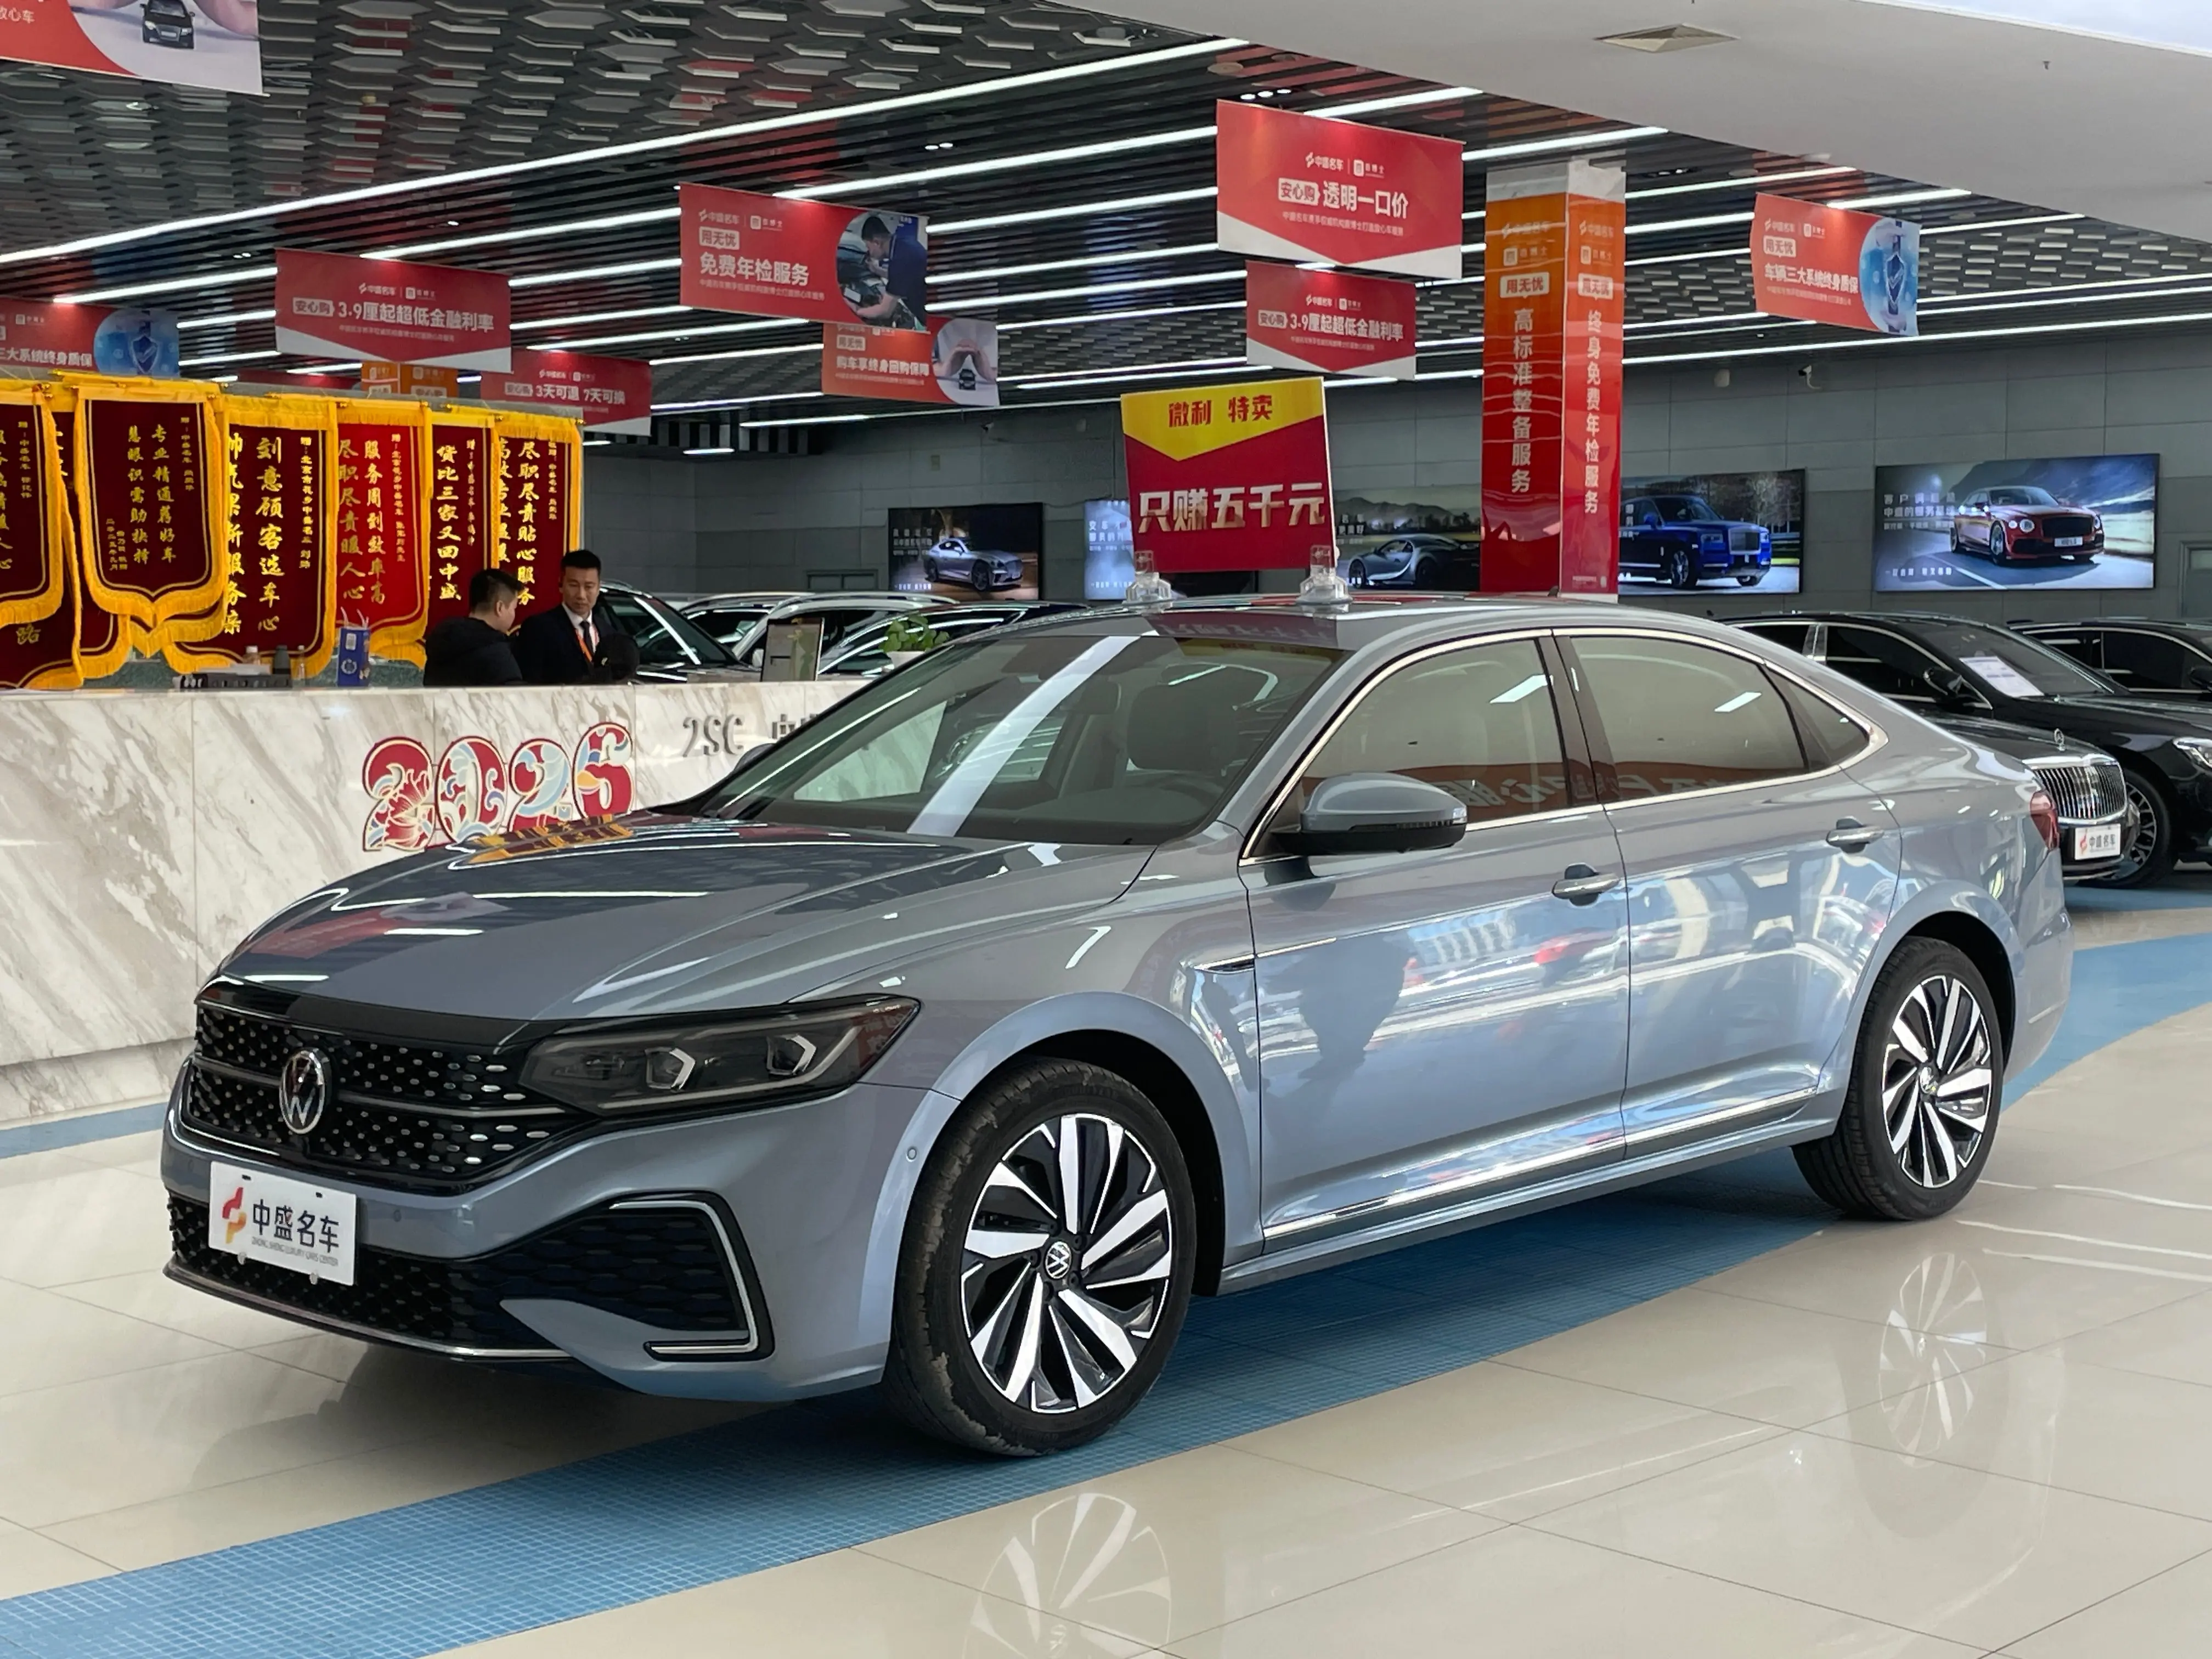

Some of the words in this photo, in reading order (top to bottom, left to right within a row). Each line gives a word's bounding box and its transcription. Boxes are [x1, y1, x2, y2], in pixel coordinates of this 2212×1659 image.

[1281, 182, 1315, 201] 安心购
[1323, 180, 1409, 219] 透明一口价
[699, 251, 809, 286] 免费年检服务
[1506, 277, 1544, 294] 用无忧
[1764, 263, 1859, 294] 车辆三大系统终身质保
[295, 300, 330, 316] 安心购
[535, 384, 579, 401] 3天可退
[583, 388, 625, 405] 7天可换
[1168, 399, 1212, 428] 微利
[1228, 394, 1273, 424] 特卖
[1511, 307, 1534, 493] 高标准整备服务
[1584, 309, 1603, 514] 终身免费年检服务
[1138, 482, 1325, 534] 只赚五千元
[252, 1199, 339, 1254] 中盛名车
